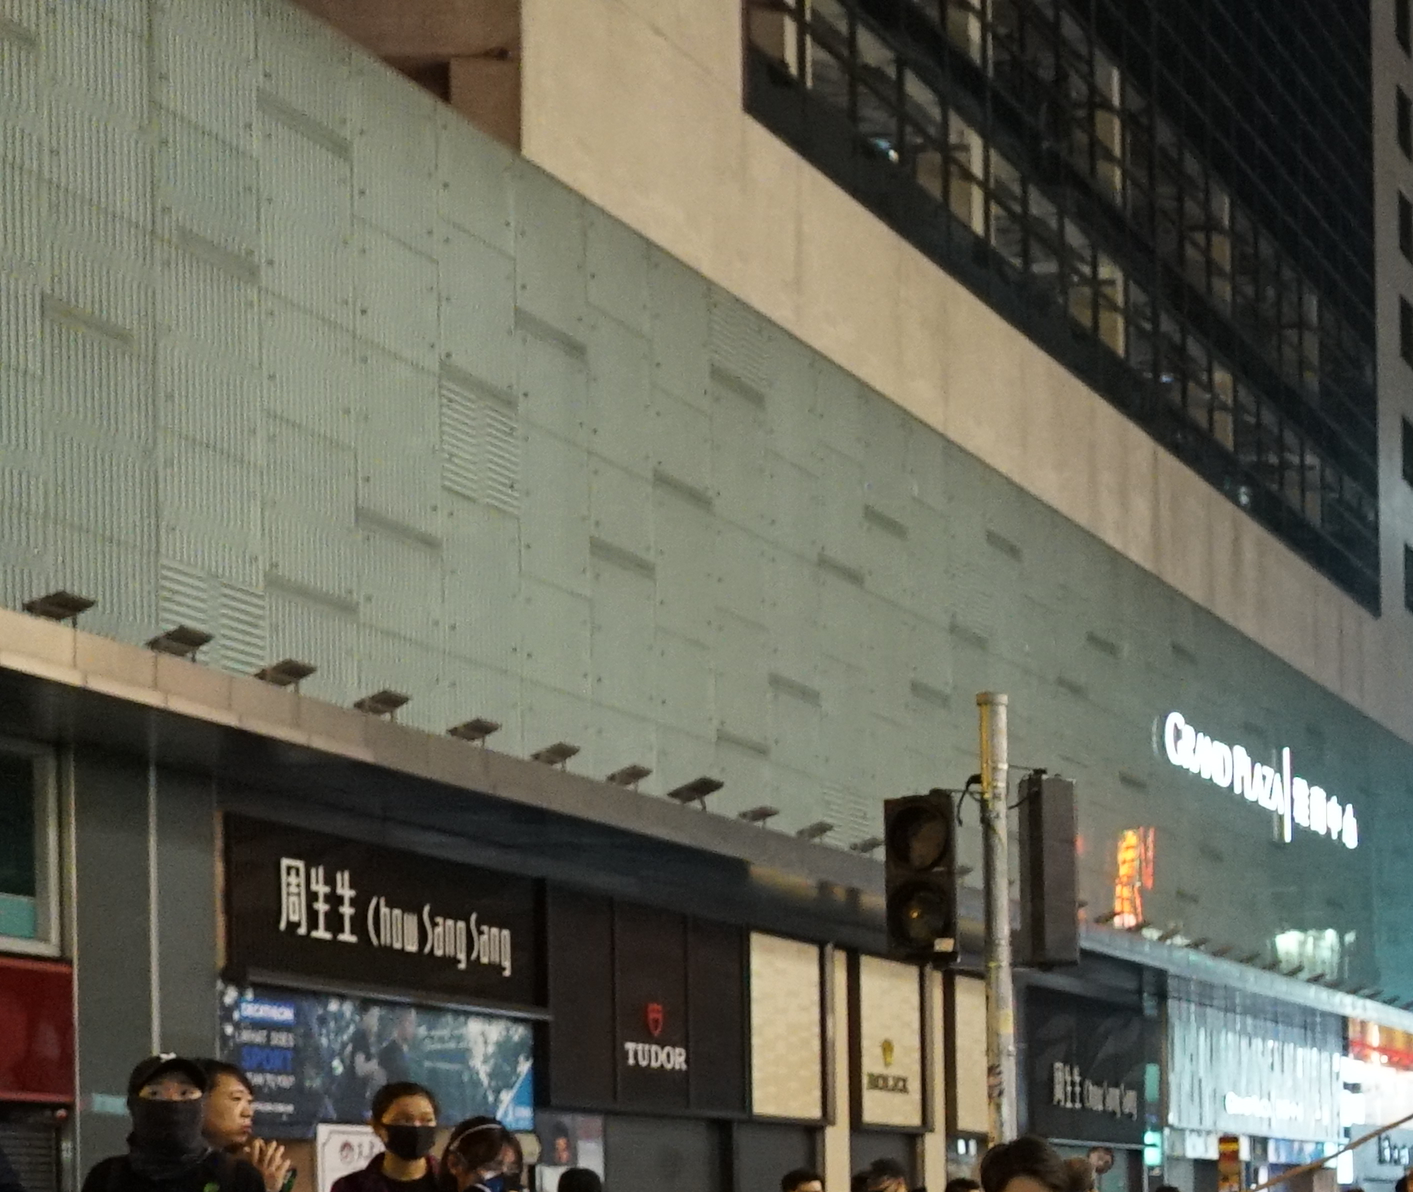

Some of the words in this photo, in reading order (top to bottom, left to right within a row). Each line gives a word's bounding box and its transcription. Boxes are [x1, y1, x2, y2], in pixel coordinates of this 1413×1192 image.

[279, 857, 357, 944] 周生生
[367, 895, 419, 953] Chow
[422, 902, 468, 971] Sang
[469, 911, 512, 978] Sang
[625, 1042, 688, 1071] TUDOR
[866, 1072, 910, 1095] ROLEX
